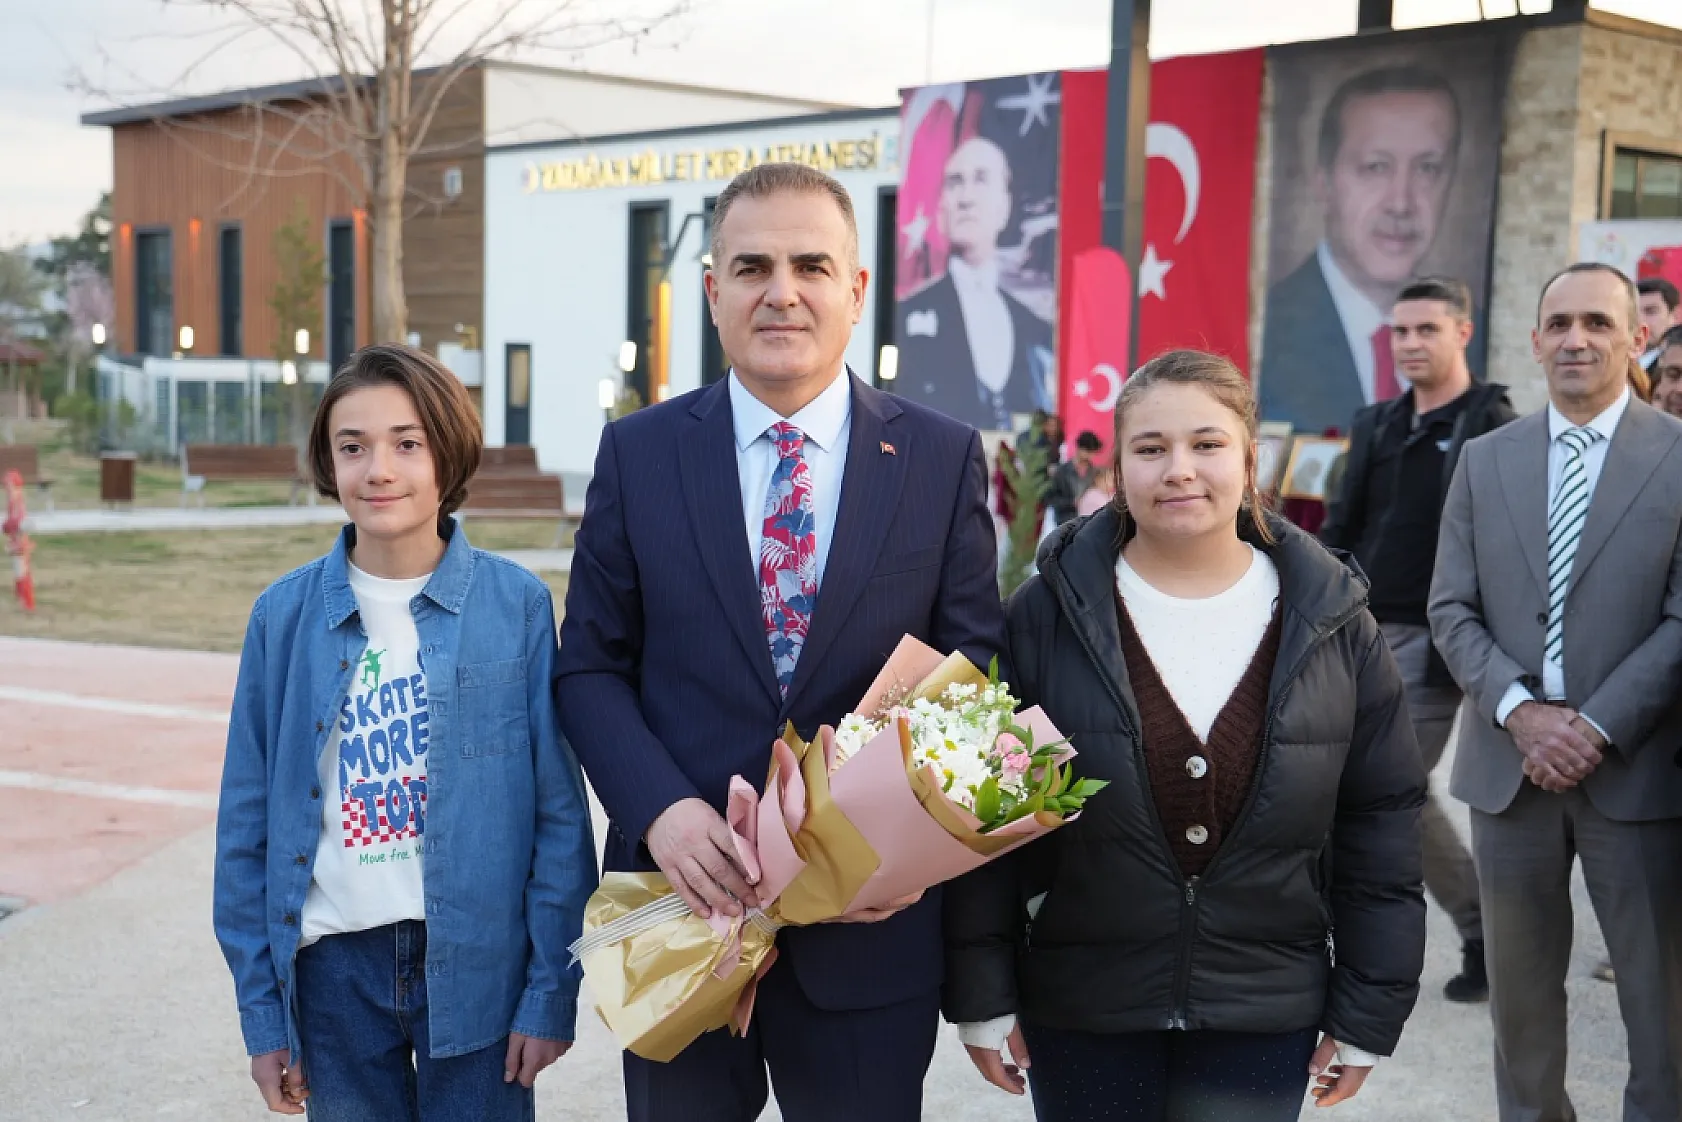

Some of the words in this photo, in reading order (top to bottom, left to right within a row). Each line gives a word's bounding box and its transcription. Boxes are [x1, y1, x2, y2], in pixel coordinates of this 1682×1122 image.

[339, 674, 428, 734] SKATE
[339, 712, 429, 801] MORE
[359, 853, 386, 865] Move
